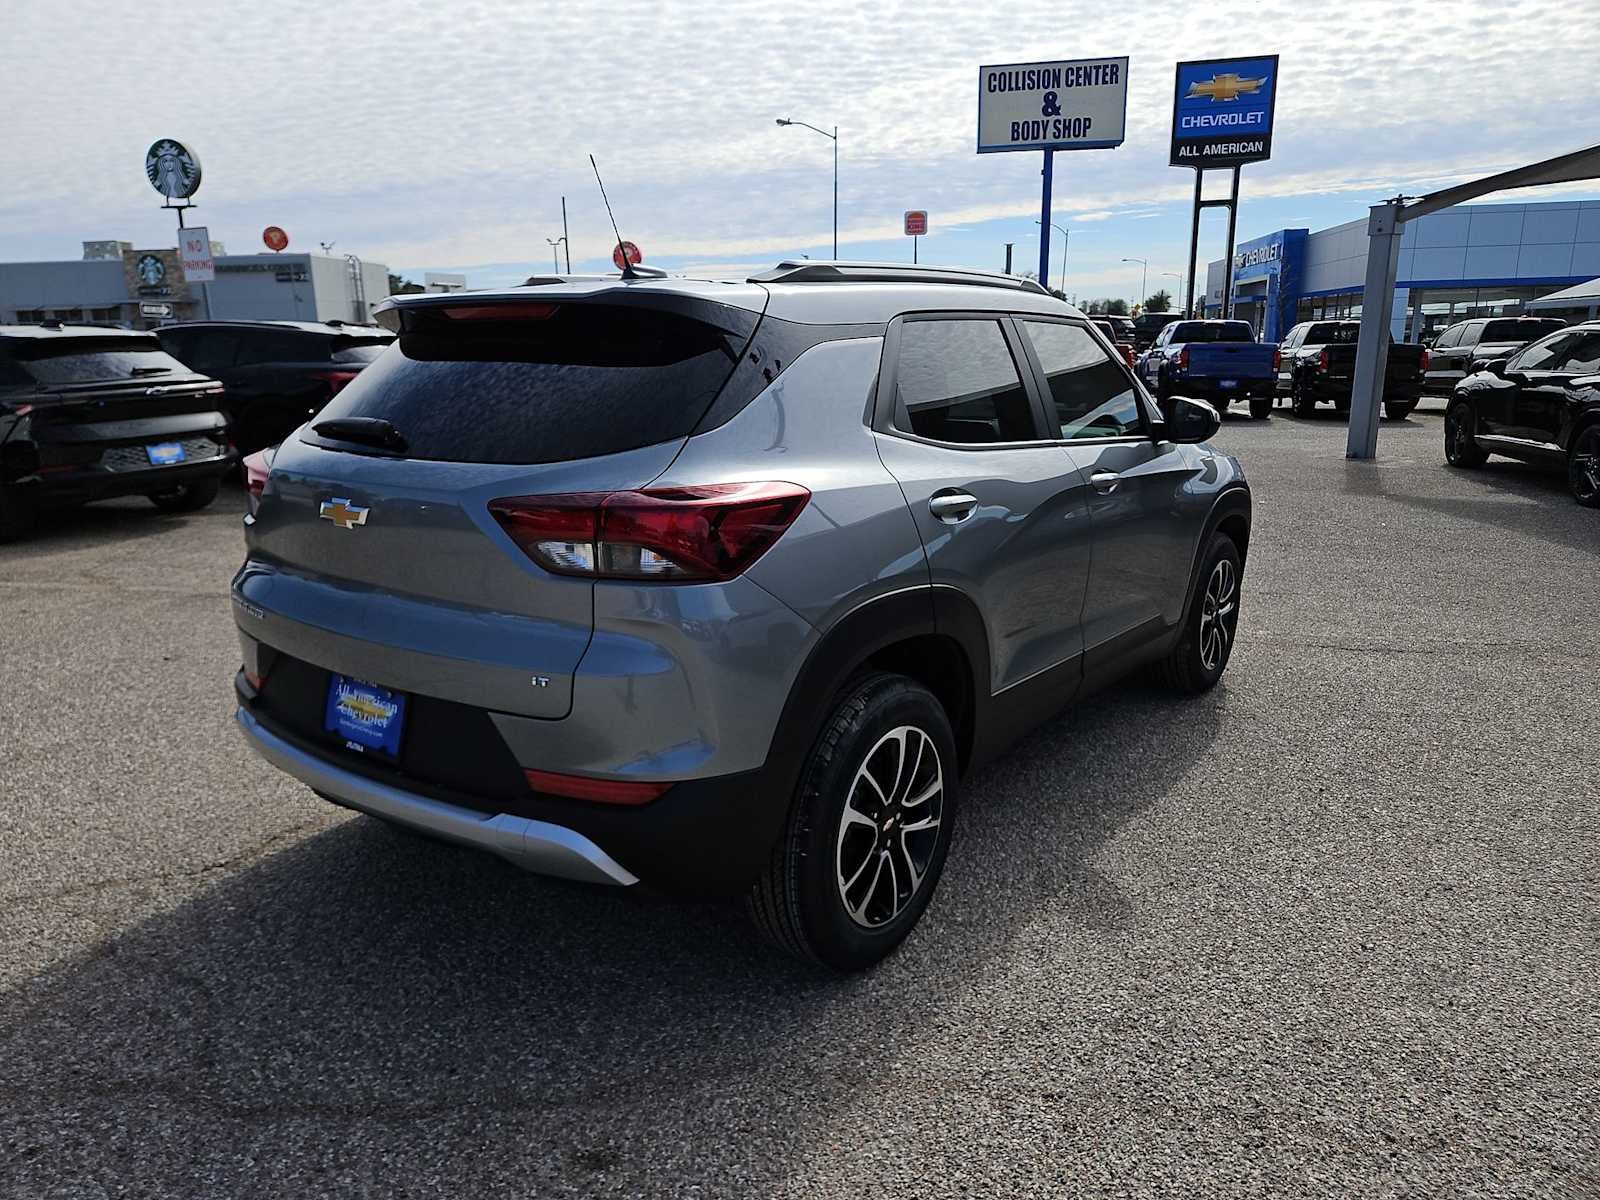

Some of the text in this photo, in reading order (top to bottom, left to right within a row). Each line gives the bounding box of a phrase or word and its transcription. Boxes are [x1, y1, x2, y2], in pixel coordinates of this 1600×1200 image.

[988, 63, 1119, 93] COLLISION CENTER
[1041, 91, 1062, 117] &
[1011, 117, 1092, 142] BODY SHOP
[1181, 111, 1265, 129] CHEVROLET
[1178, 141, 1264, 157] ALL AMERICAN
[187, 239, 202, 252] NO
[1245, 243, 1279, 267] CHEVROLET
